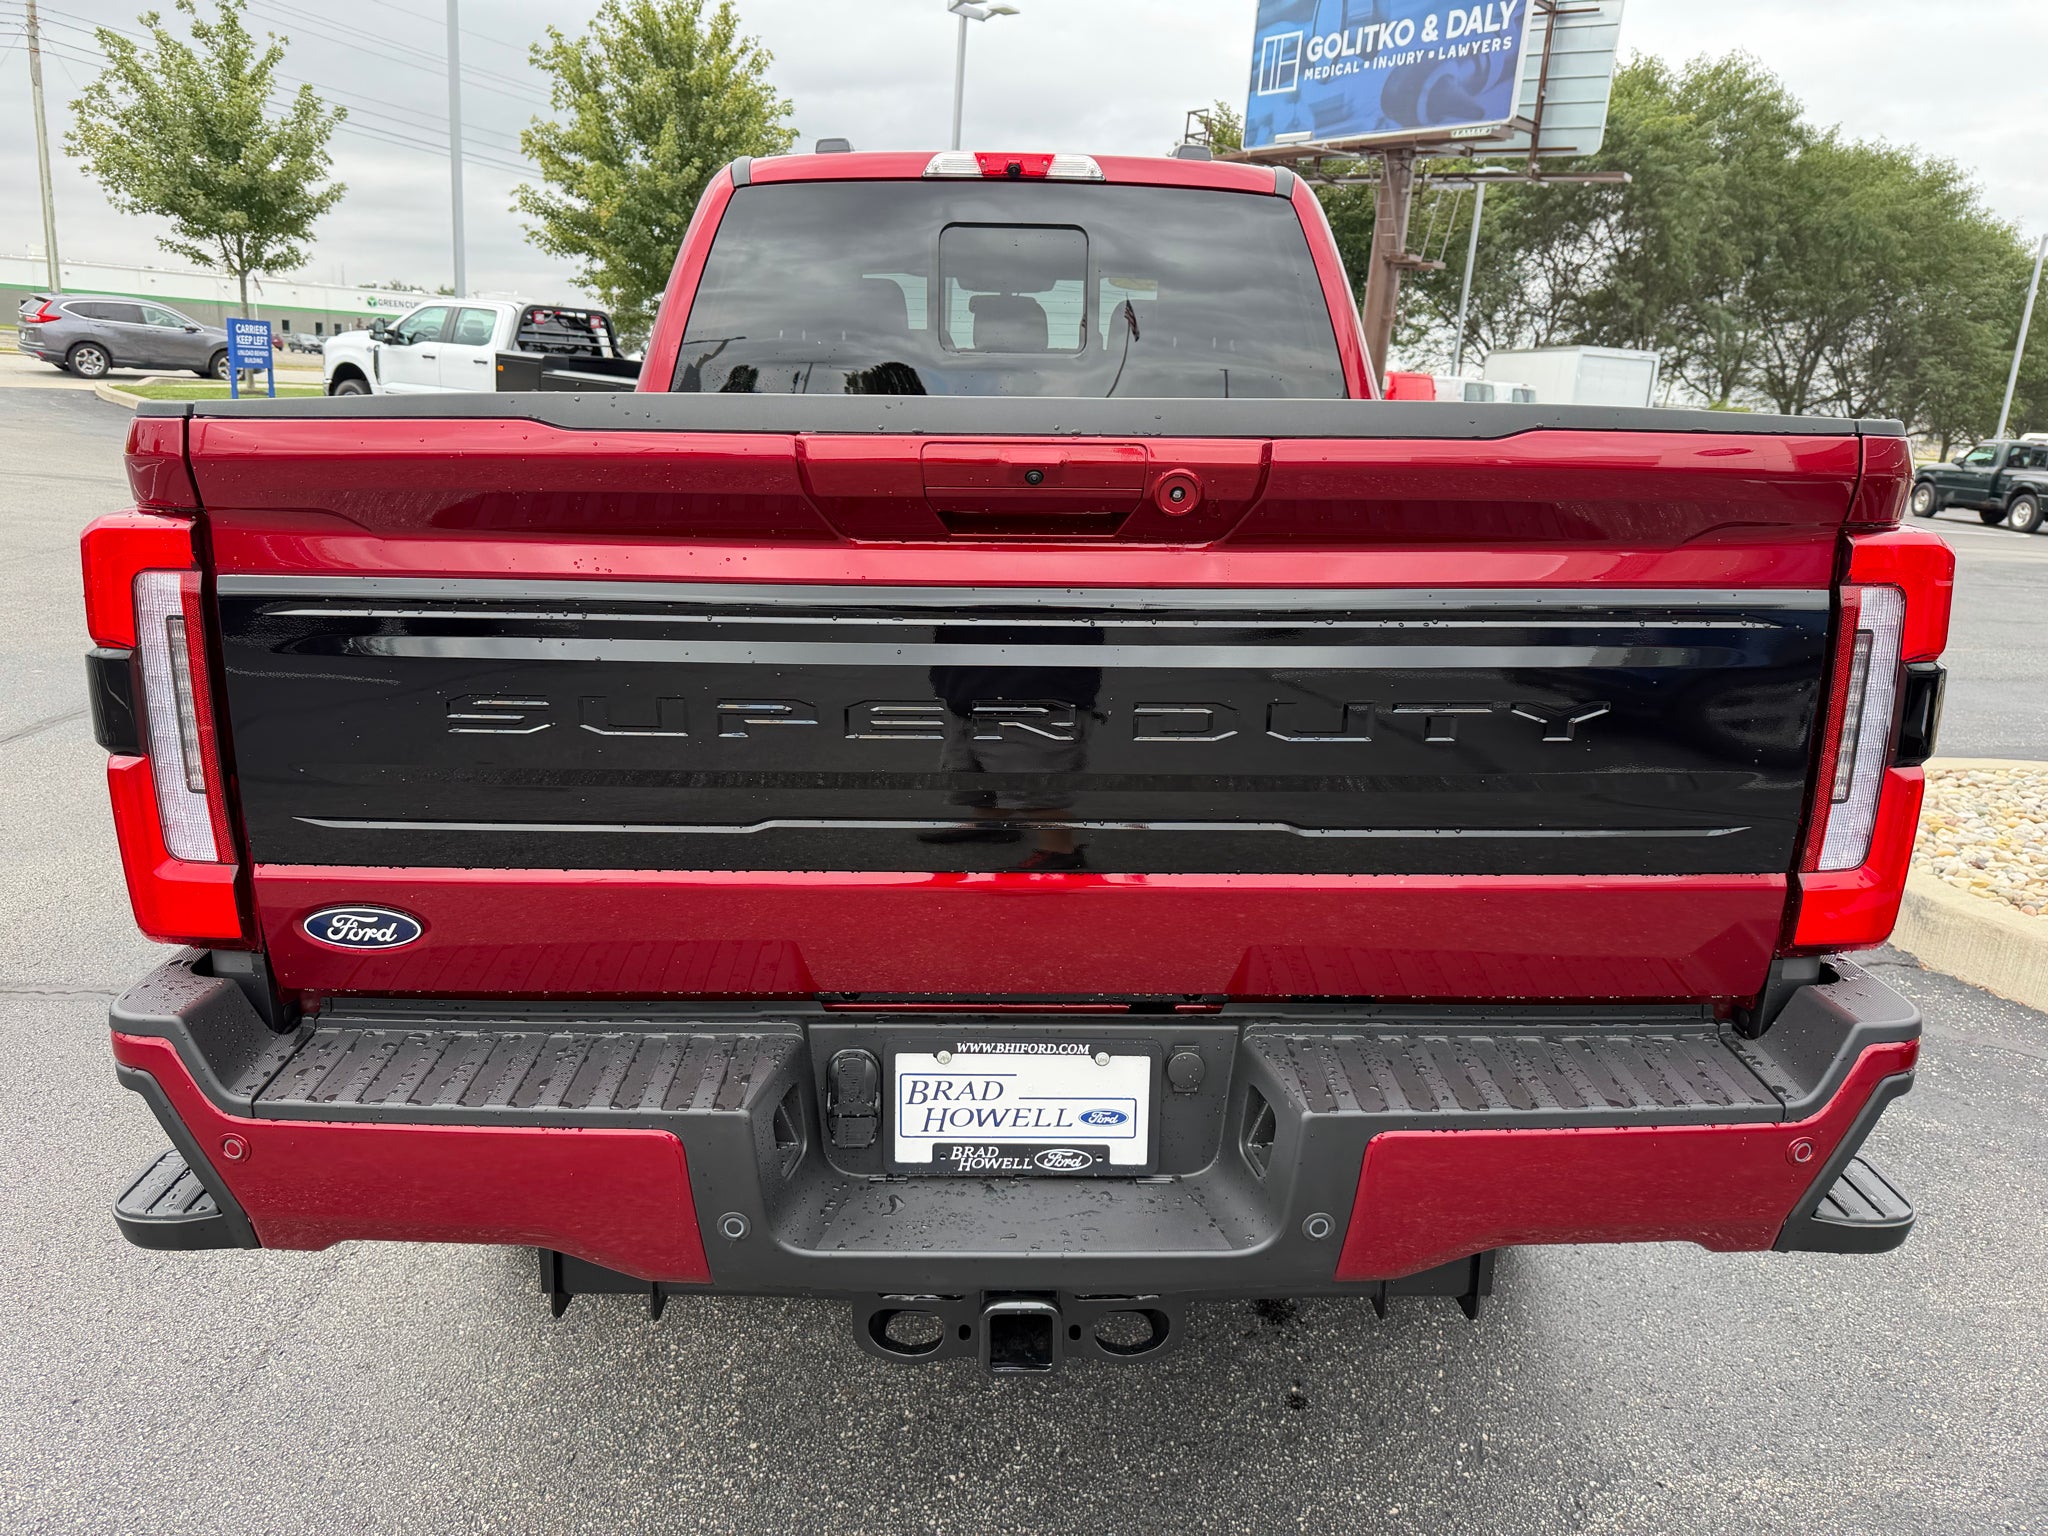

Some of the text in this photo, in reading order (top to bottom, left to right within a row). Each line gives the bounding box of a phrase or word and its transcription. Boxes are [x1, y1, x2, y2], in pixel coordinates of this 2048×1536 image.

[1306, 0, 1518, 63] GOLITKO & DALY
[1304, 36, 1513, 81] MEDICAL INJURY LAWYERS
[235, 323, 268, 335] CARRIERS
[236, 334, 268, 346] KEEP LEFT
[446, 694, 1611, 742] SUPER DUTY
[327, 914, 398, 942] Ford
[956, 1042, 1090, 1055] WWW.BHIFORD.COM
[905, 1080, 1005, 1105] BRAD
[921, 1107, 1119, 1132] HOWELL Ford
[950, 1146, 999, 1160] BRAD
[957, 1151, 1083, 1172] HOWELL Ford
